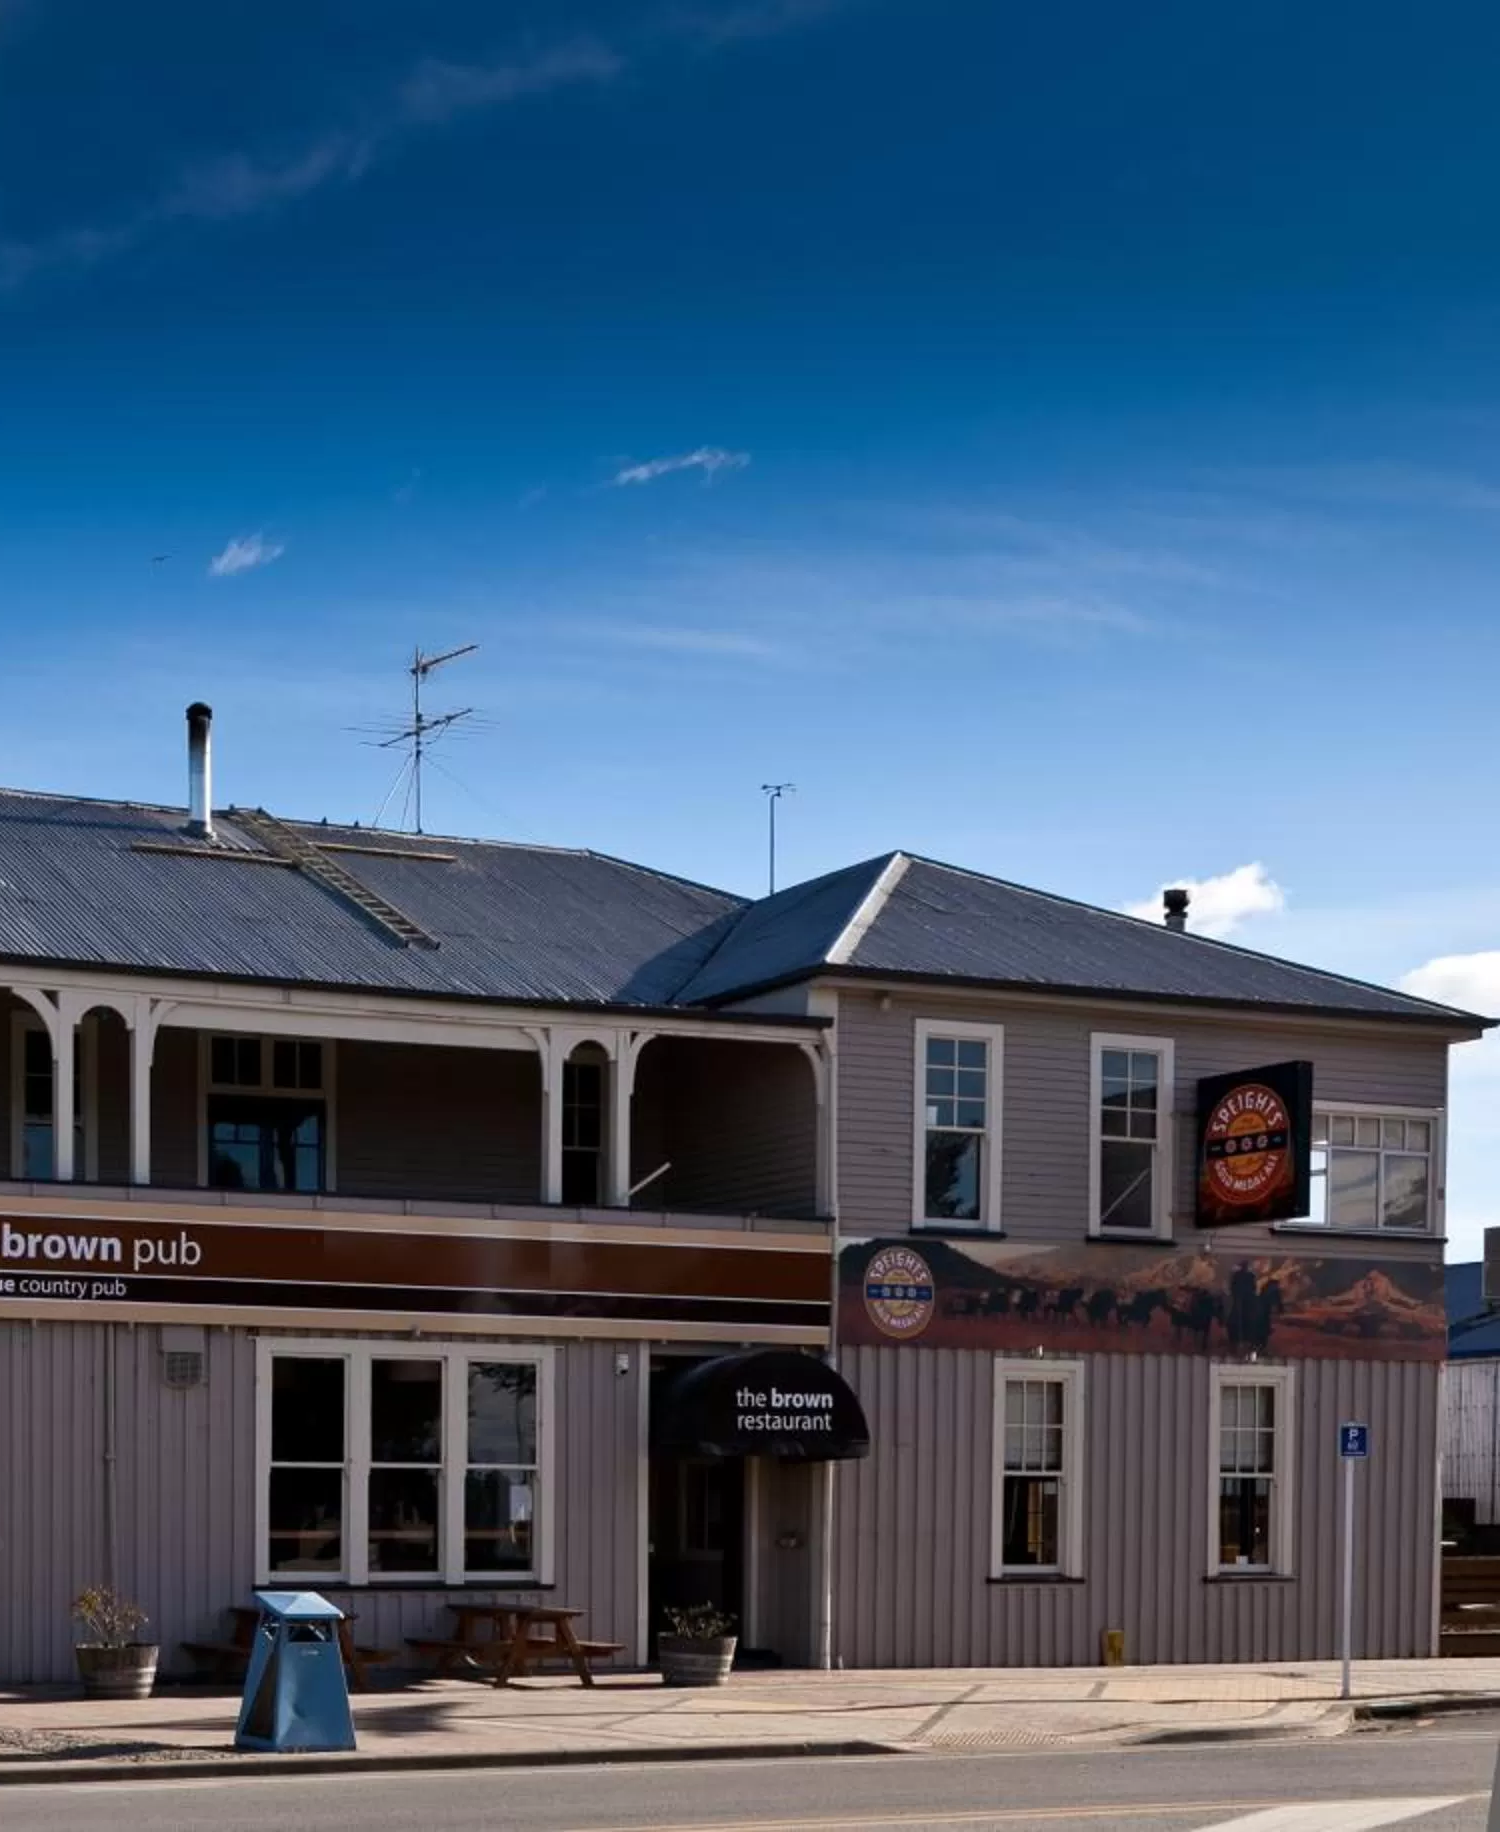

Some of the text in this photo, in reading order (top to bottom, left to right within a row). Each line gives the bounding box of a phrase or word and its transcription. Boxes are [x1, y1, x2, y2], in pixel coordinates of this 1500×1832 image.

[1, 1222, 122, 1262] brown
[133, 1232, 201, 1271] pub
[19, 1279, 87, 1298] country
[91, 1279, 127, 1299] pub
[736, 1386, 833, 1408] the brown
[737, 1412, 832, 1431] restaurant
[1349, 1429, 1359, 1441] P
